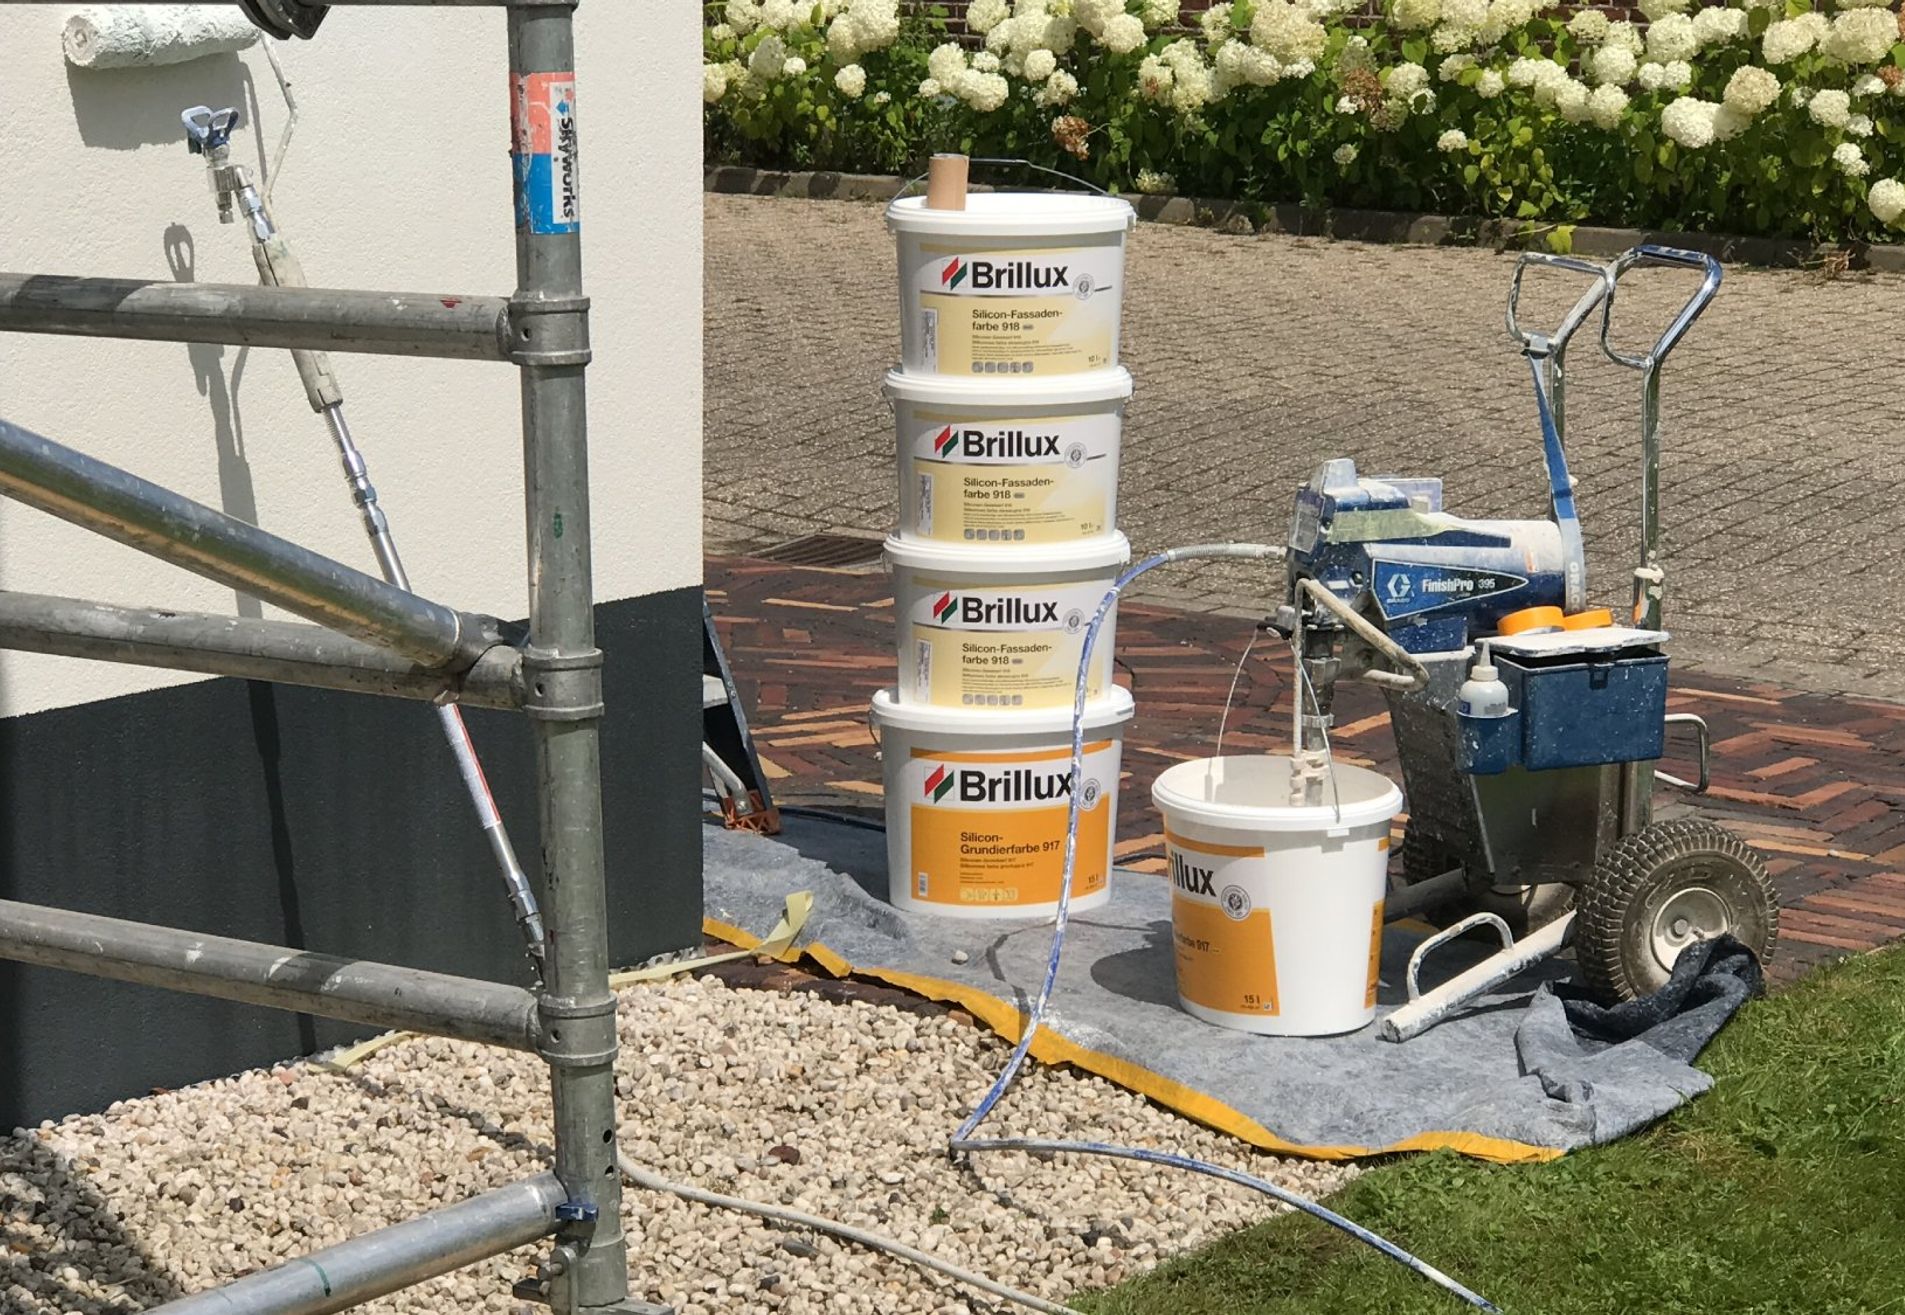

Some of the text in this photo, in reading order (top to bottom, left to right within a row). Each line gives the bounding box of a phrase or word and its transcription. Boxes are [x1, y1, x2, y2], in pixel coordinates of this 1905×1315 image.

[972, 262, 1069, 289] Brillux
[972, 309, 1063, 319] Silicon-Fassaden-
[972, 322, 1020, 331] farbe 918
[963, 430, 1060, 457] Brillux
[963, 477, 1054, 487] Silicon-Fassaden-
[963, 490, 1011, 499] farbe 918
[1422, 577, 1496, 593] FinishPro 395
[962, 597, 1058, 624] Brillux
[962, 643, 1053, 653] Silicon-Fassaden-
[962, 655, 1010, 665] farbe 918
[960, 769, 1073, 802] Brillux
[960, 832, 1003, 842] Silicon-
[960, 840, 1060, 855] Grundierfarbe 917
[1170, 850, 1217, 897] illux
[1244, 994, 1255, 1004] 15
